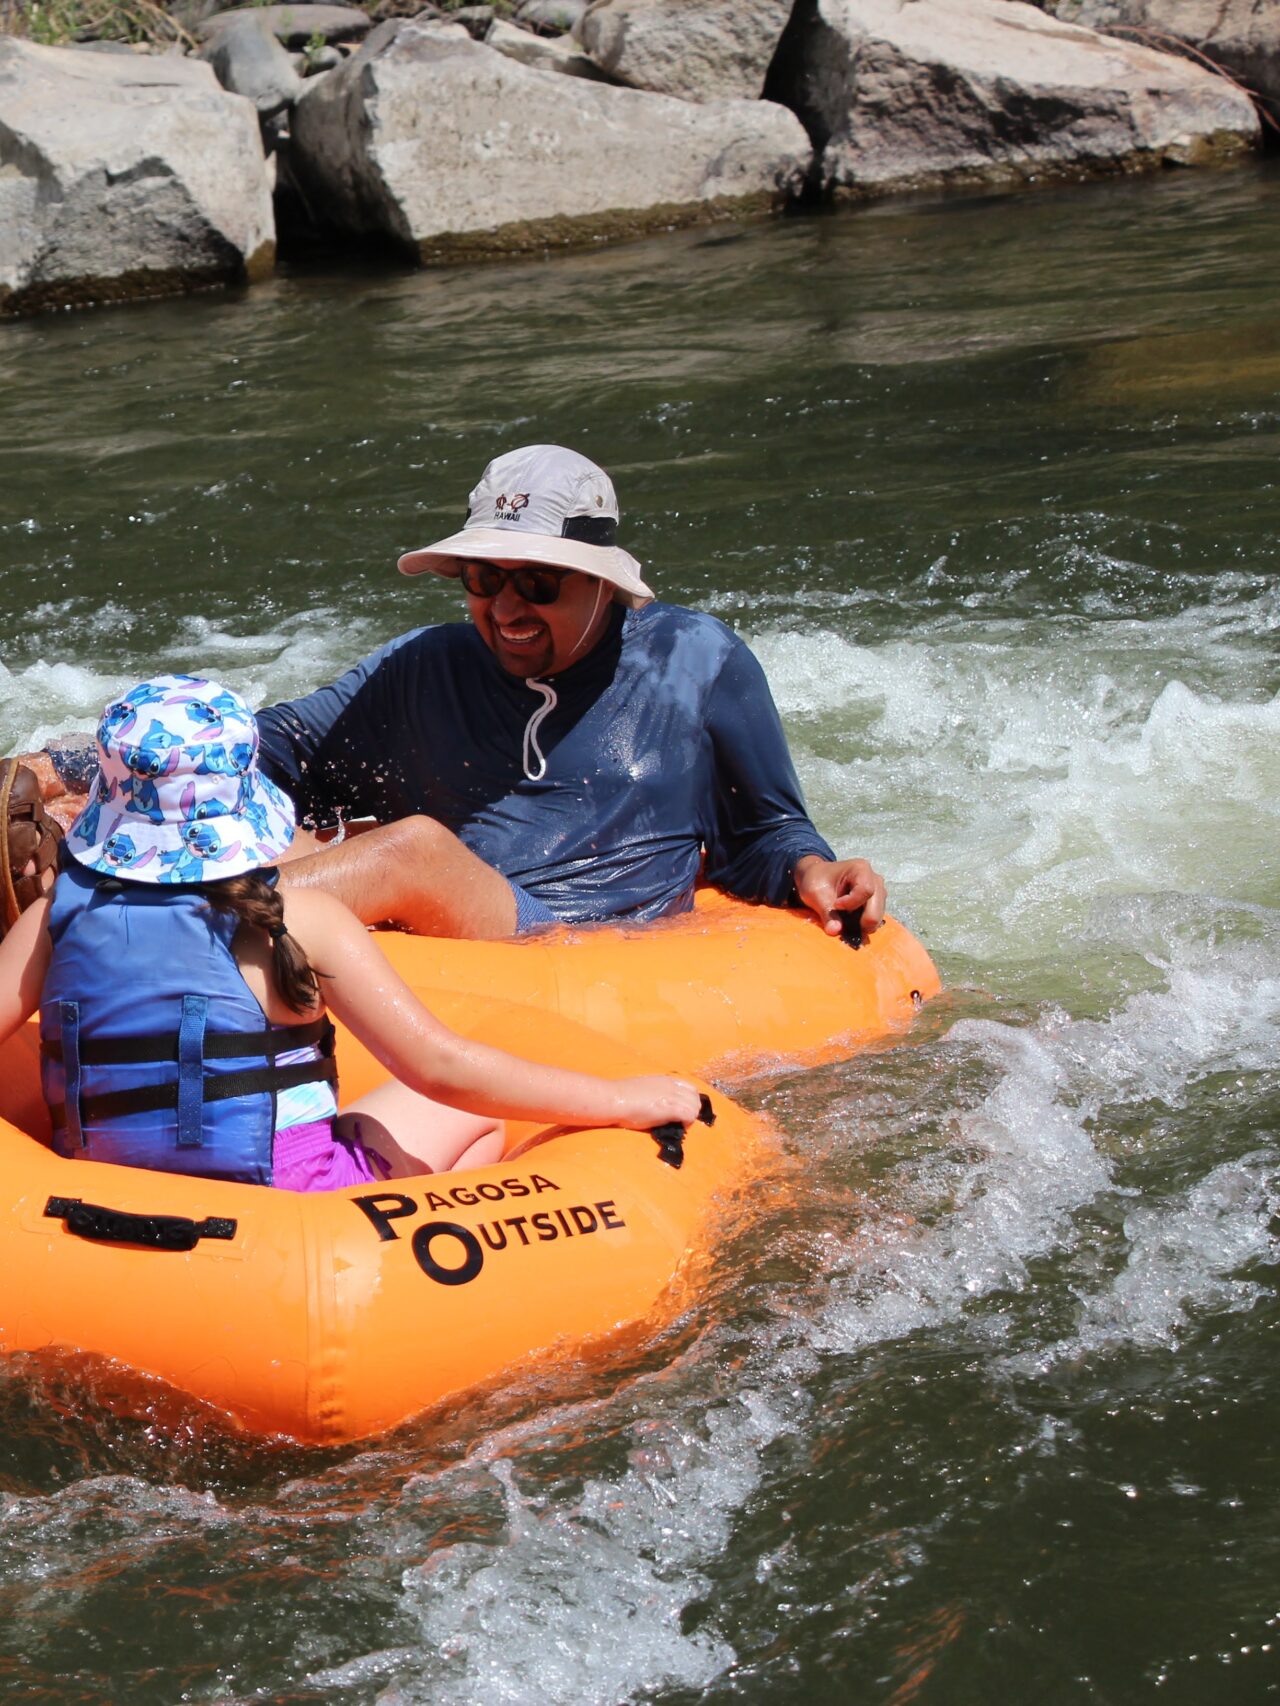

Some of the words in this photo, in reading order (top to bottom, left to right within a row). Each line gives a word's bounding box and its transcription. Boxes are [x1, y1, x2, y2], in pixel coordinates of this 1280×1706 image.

[494, 512, 522, 522] HAWAII
[349, 1174, 561, 1242] PAGOSA
[411, 1200, 626, 1286] OUTSIDE
